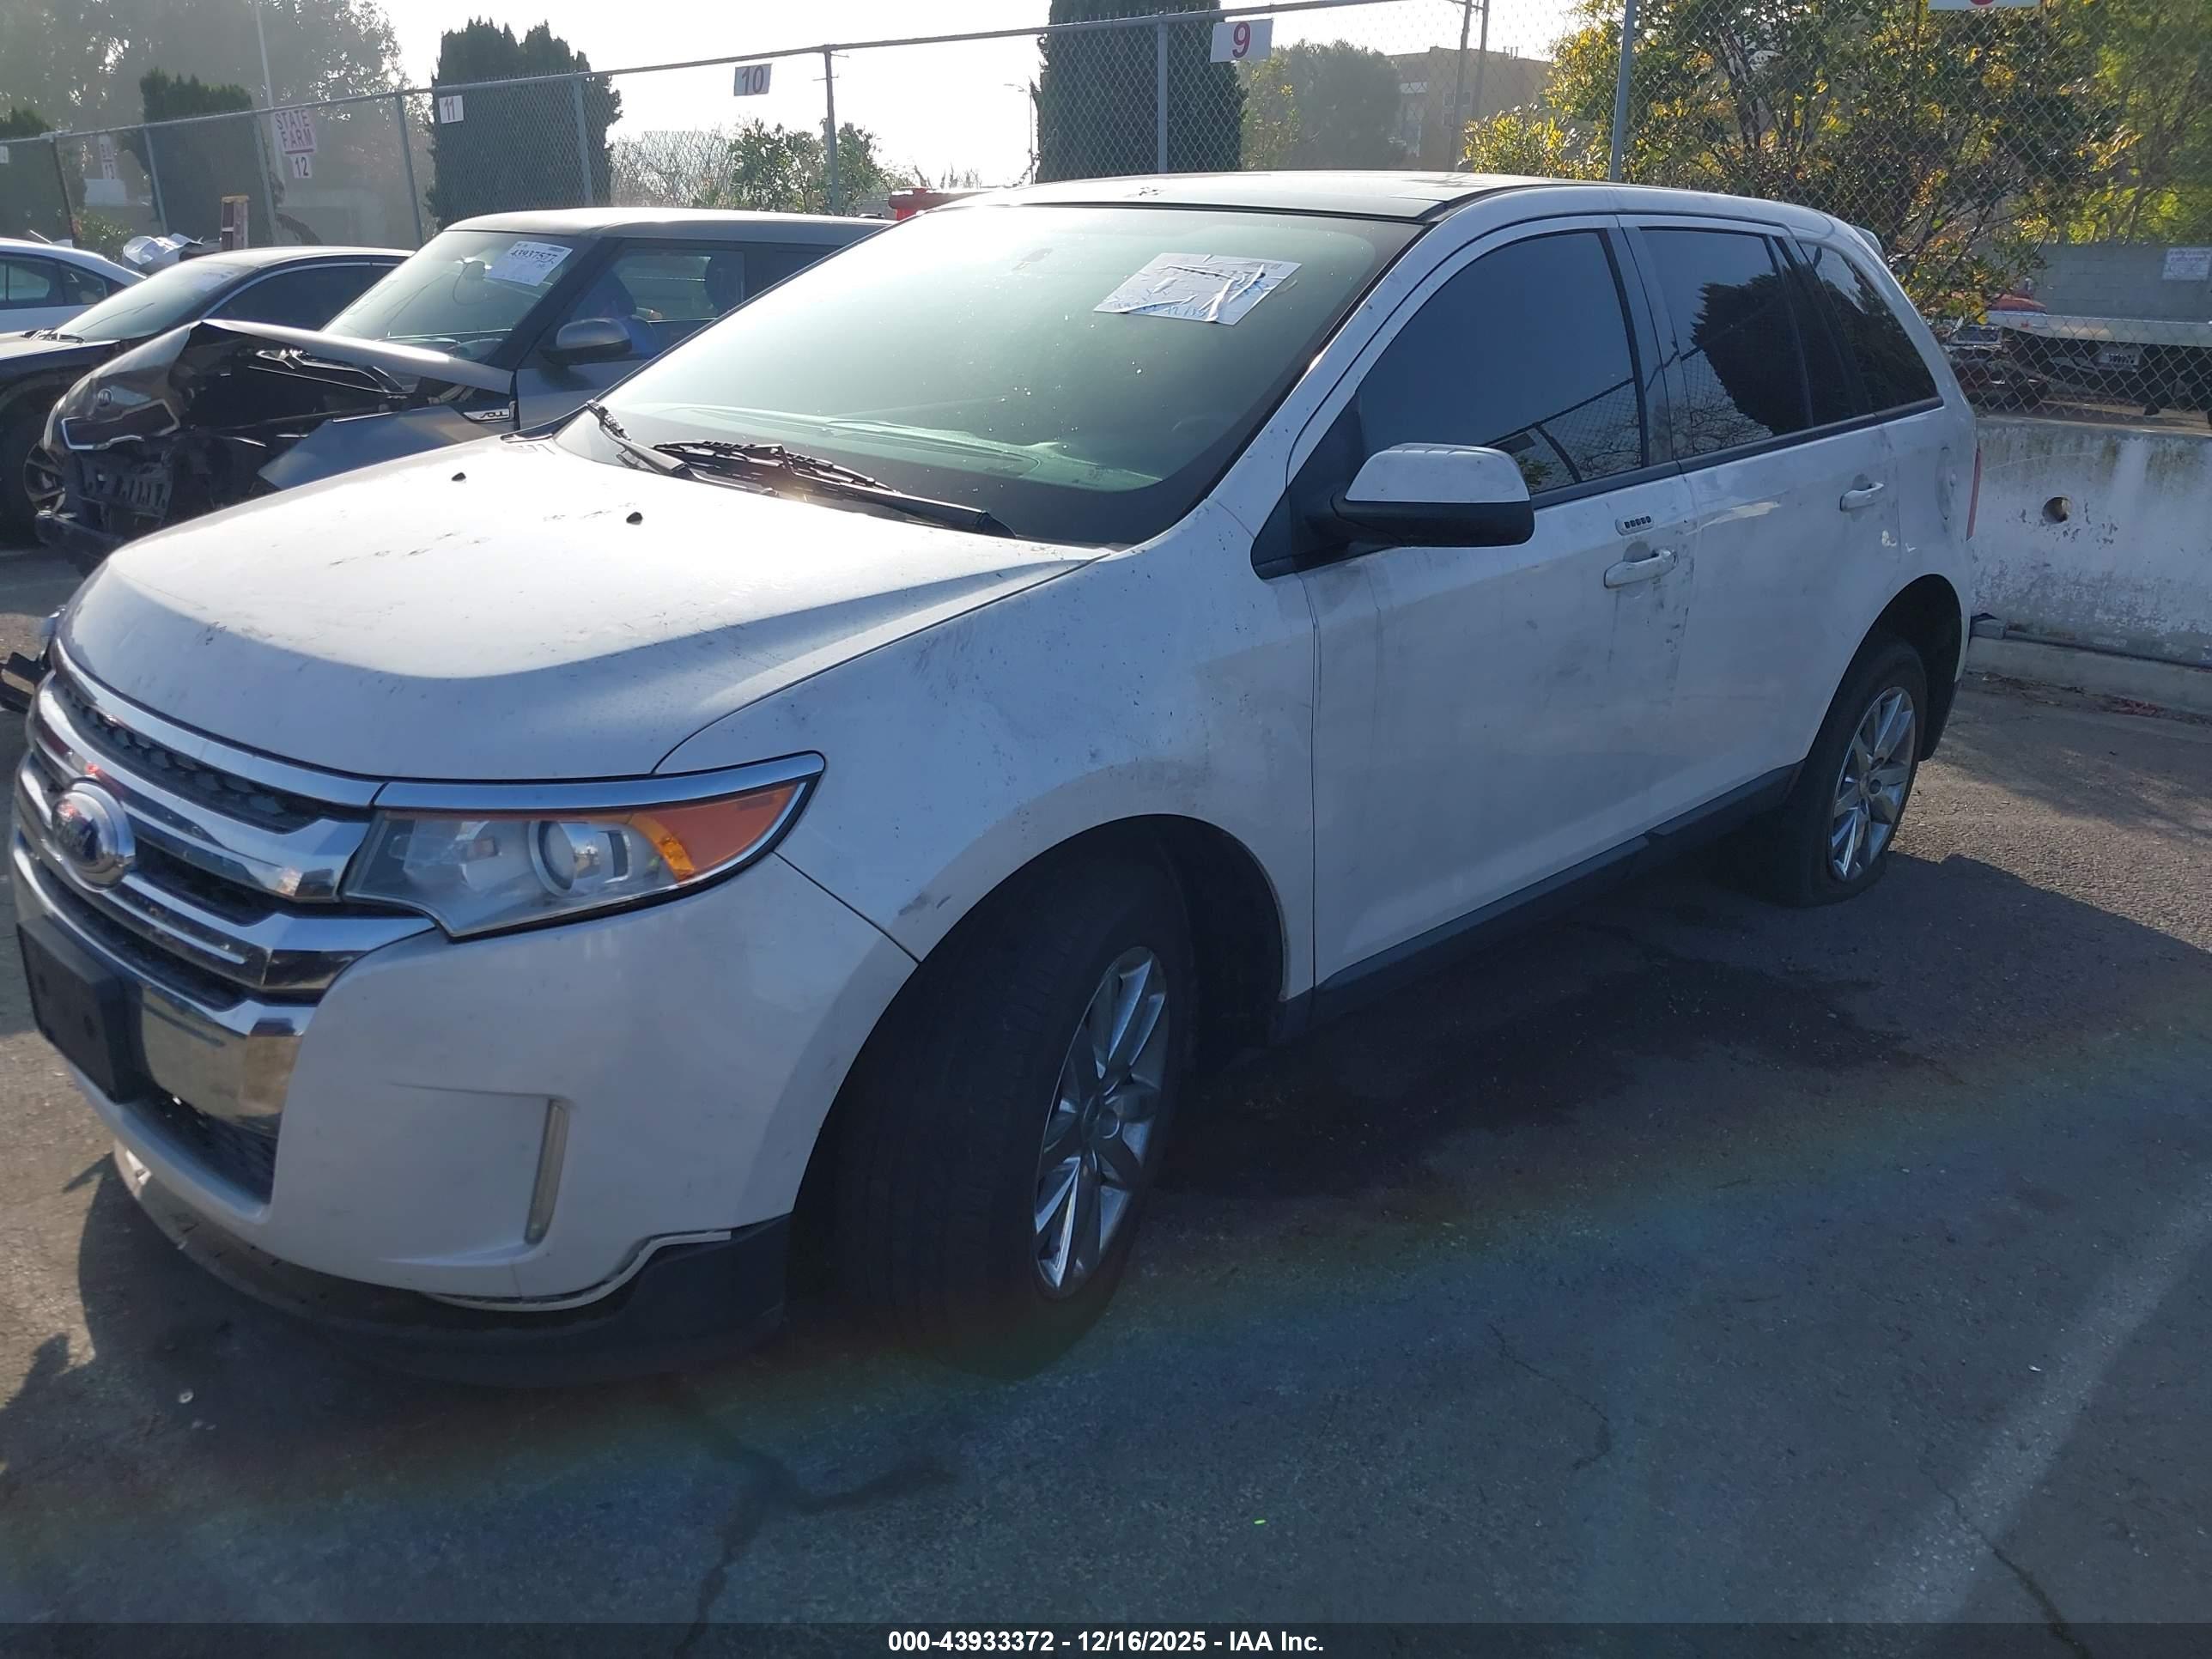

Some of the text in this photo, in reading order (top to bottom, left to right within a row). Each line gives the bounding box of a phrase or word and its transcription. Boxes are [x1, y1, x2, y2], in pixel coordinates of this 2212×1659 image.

[1232, 21, 1251, 58] 9
[741, 65, 764, 94] 10
[274, 109, 310, 130] STATE
[444, 96, 455, 121] 11
[281, 127, 314, 149] FARM
[295, 156, 309, 177] 12
